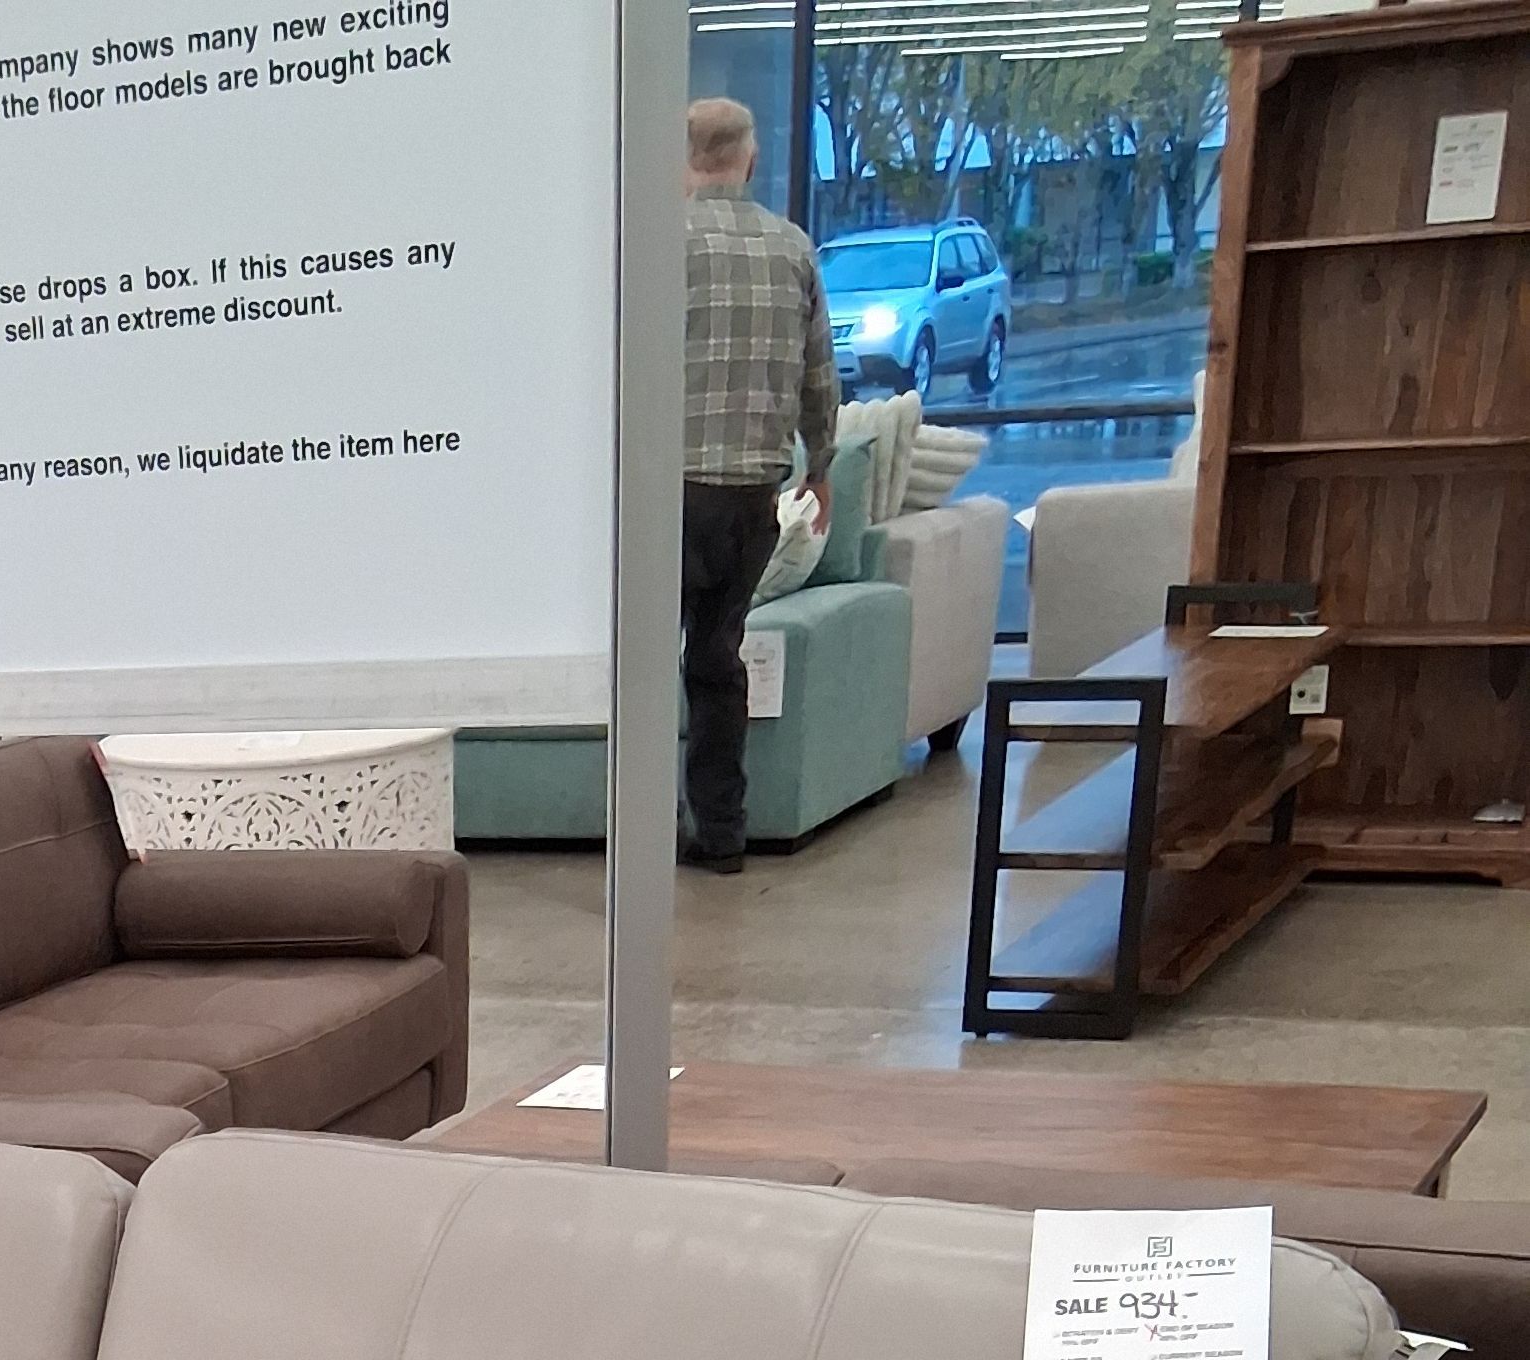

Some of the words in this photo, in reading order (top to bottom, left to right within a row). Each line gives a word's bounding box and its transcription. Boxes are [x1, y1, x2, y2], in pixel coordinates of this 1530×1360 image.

[92, 37, 174, 66] shows
[188, 25, 258, 53] many
[273, 16, 326, 42] new
[341, 0, 448, 33] exciting
[1, 93, 39, 119] the
[48, 87, 105, 112] floor
[115, 70, 207, 104] models
[218, 68, 258, 91] are
[269, 48, 375, 85] brought
[386, 38, 451, 70] back
[38, 276, 107, 303] drops
[119, 274, 132, 292] a
[146, 266, 198, 289] box.
[212, 258, 226, 284] If
[240, 253, 286, 281] this
[301, 248, 393, 275] causes
[408, 241, 455, 269] any
[5, 315, 44, 342] sell
[53, 314, 74, 338] at
[81, 316, 109, 335] an
[118, 305, 215, 332] extreme
[224, 289, 342, 322] discount.
[44, 456, 129, 478] reason,
[137, 453, 170, 472] we
[178, 441, 283, 473] liquidate
[292, 437, 331, 461] the
[340, 434, 393, 458] item
[404, 429, 460, 454] here
[1073, 1261, 1159, 1274] FURNITURE
[1166, 1257, 1237, 1270] FACTORY
[1054, 1297, 1109, 1316] SALE
